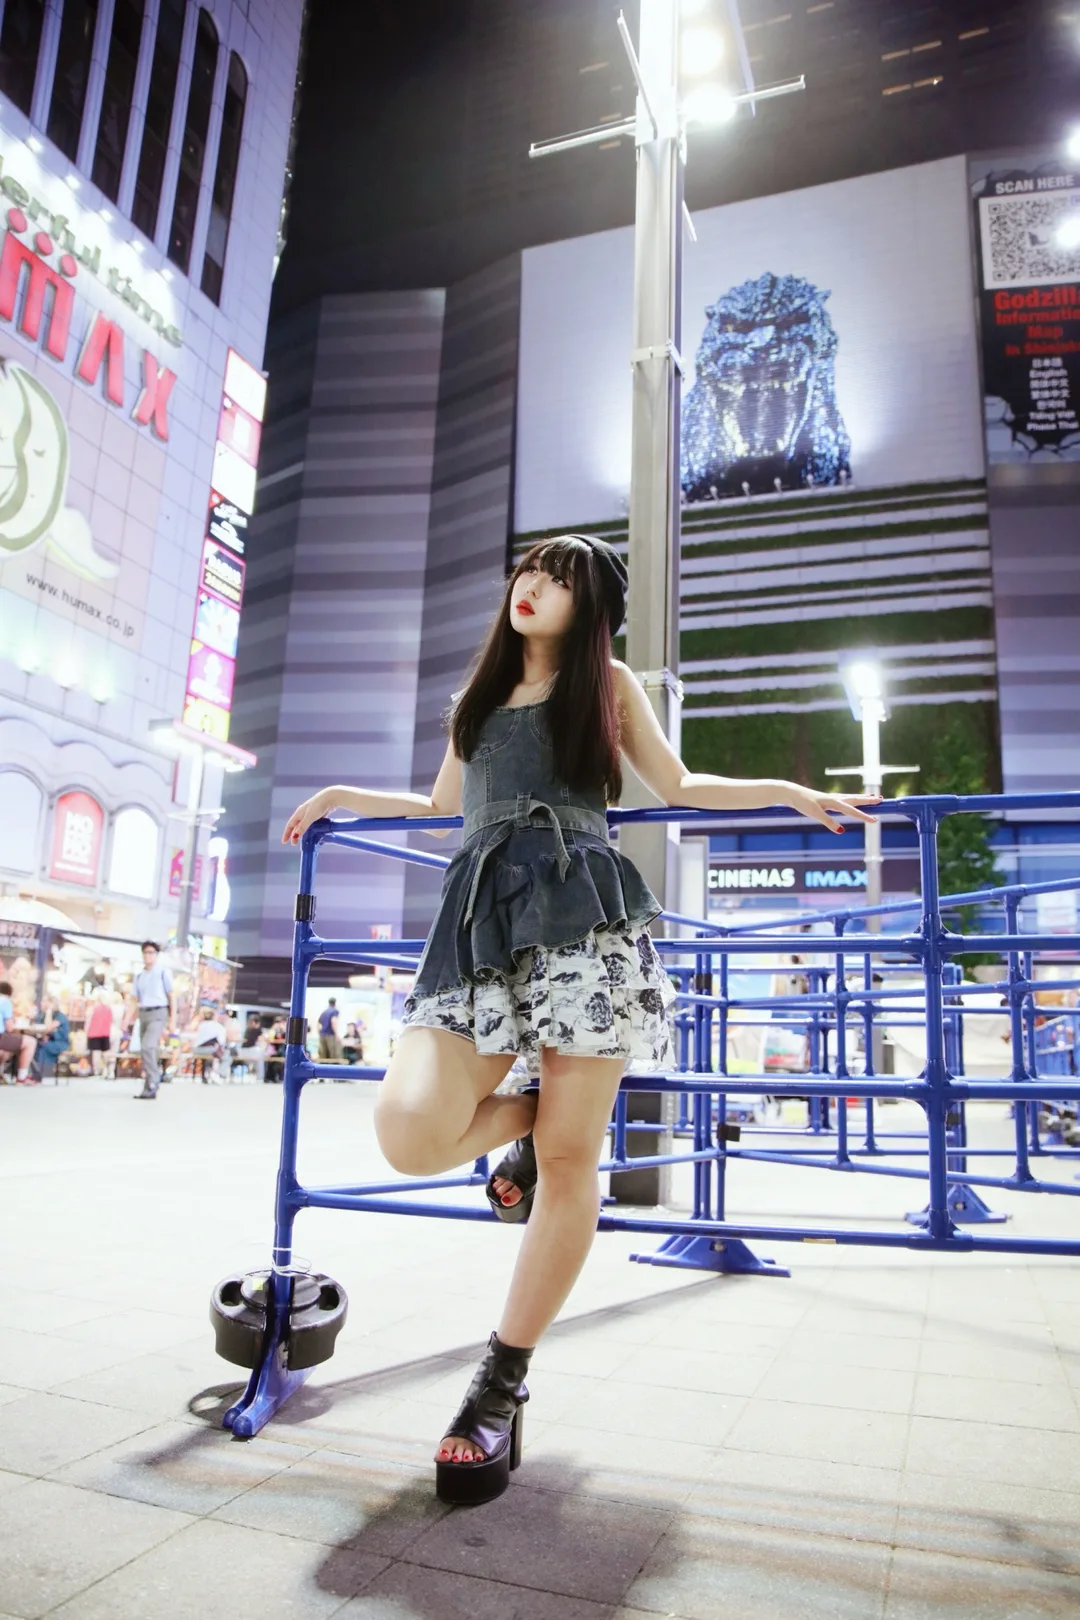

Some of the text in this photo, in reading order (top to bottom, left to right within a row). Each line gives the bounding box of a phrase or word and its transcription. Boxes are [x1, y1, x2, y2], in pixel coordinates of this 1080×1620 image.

[995, 174, 1075, 195] SCAN HERE
[107, 266, 182, 348] time
[995, 286, 1080, 311] Godzill
[25, 572, 135, 638] www.humax.co.jp
[707, 868, 869, 888] CINEMAS IMAX
